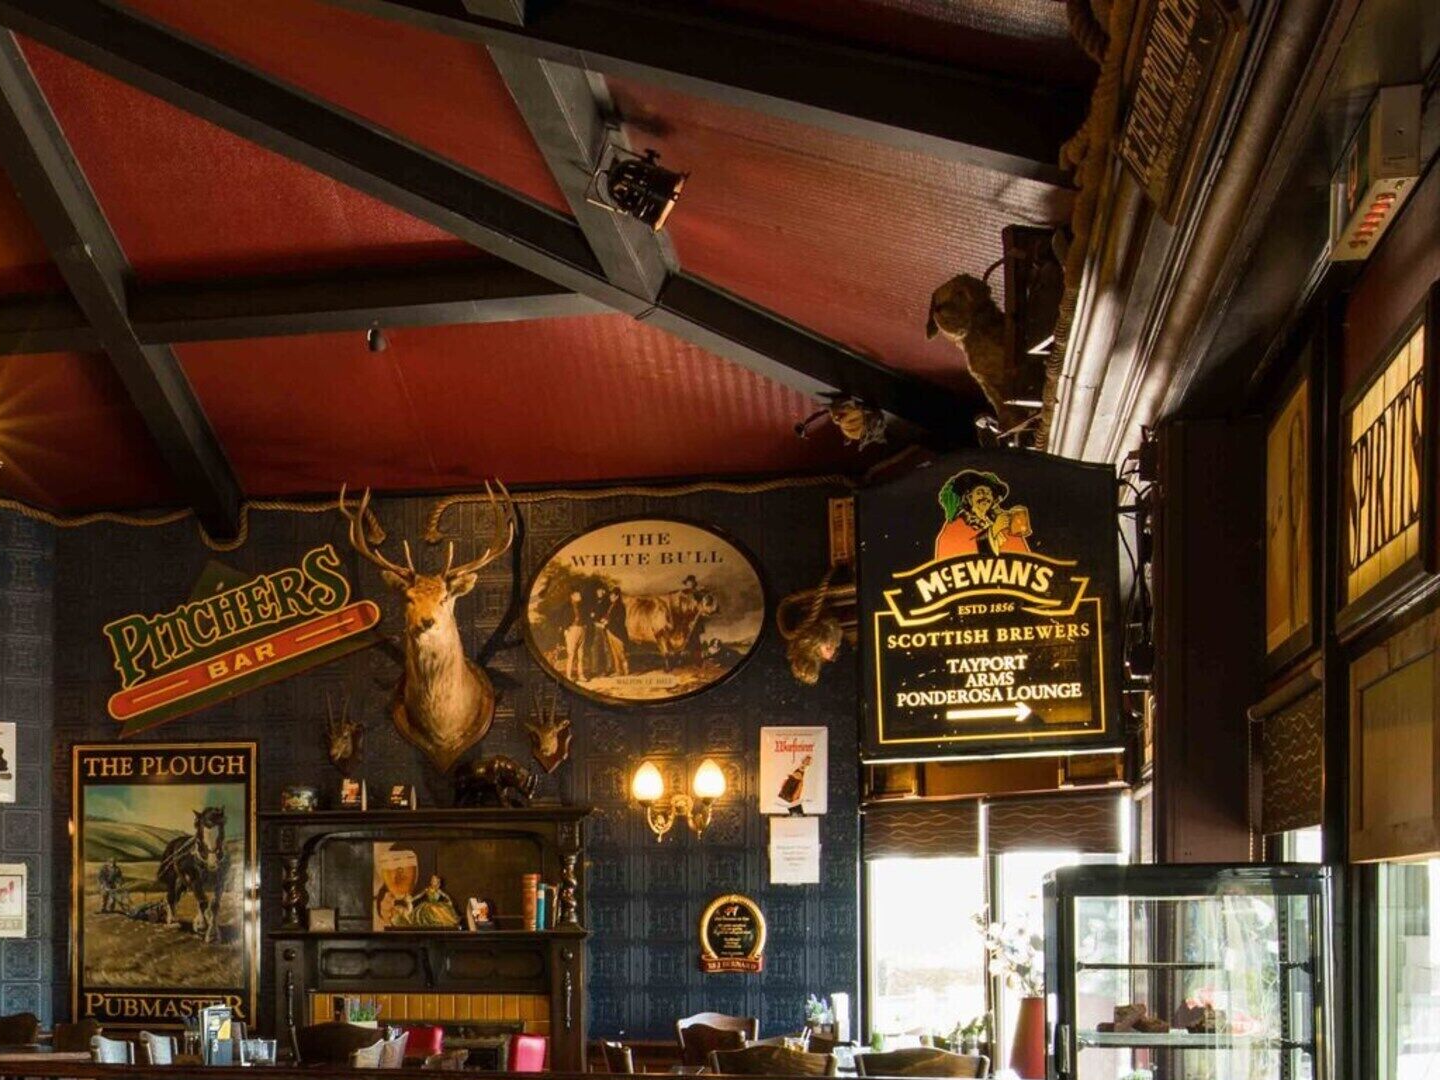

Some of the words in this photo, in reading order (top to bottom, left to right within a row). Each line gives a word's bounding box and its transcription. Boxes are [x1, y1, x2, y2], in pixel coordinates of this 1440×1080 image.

[1350, 367, 1424, 570] SPIRITS
[621, 532, 671, 547] THE
[570, 552, 651, 567] WHITE
[660, 550, 724, 565] BULL
[103, 544, 351, 690] PITCHERS
[958, 604, 987, 615] ESTD
[990, 602, 1015, 613] 1856
[887, 629, 989, 649] SCOTTISH
[997, 622, 1090, 642] BREWERS
[207, 642, 276, 680] BAR
[946, 654, 1028, 673] TAYPORT
[965, 671, 1015, 688] ARMS
[897, 688, 1004, 707] PONDEROSA
[1007, 682, 1082, 701] LOUNGE
[83, 757, 133, 777] THE
[140, 755, 246, 776] PLOUGH
